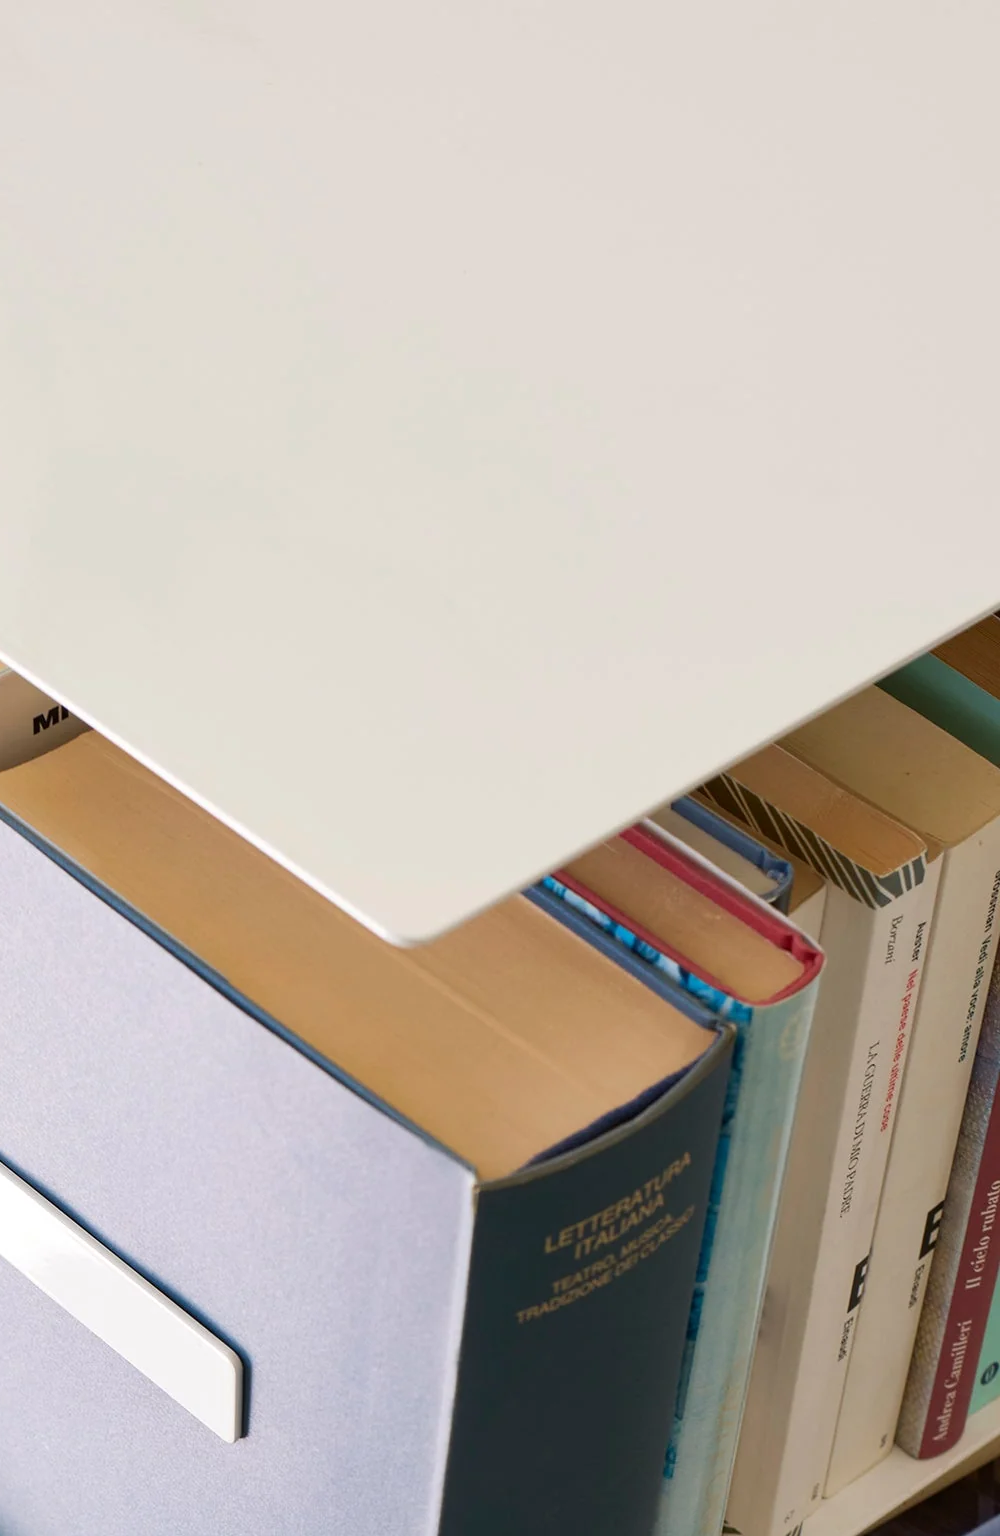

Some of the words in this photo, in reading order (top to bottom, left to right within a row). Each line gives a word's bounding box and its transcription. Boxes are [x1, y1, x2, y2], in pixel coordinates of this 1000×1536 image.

[885, 915, 903, 965] Borzani
[911, 921, 927, 962] Auster
[978, 934, 992, 964] Vedi
[904, 969, 919, 990] Nel
[973, 966, 984, 989] alla
[898, 993, 912, 1031] paese
[965, 989, 979, 1024] voce:
[892, 1032, 907, 1062] delle
[958, 1024, 973, 1063] amore
[855, 1064, 878, 1127] GUERRA
[885, 1062, 900, 1102] ultime
[880, 1100, 892, 1134] cose
[544, 1152, 691, 1254] LETTERATURA
[980, 1179, 1000, 1235] rubato
[574, 1192, 664, 1260] ITALIANA
[971, 1234, 991, 1274] cielo
[965, 1275, 982, 1290] Il
[944, 1319, 972, 1388] Camilleri
[933, 1388, 957, 1442] Andrea
